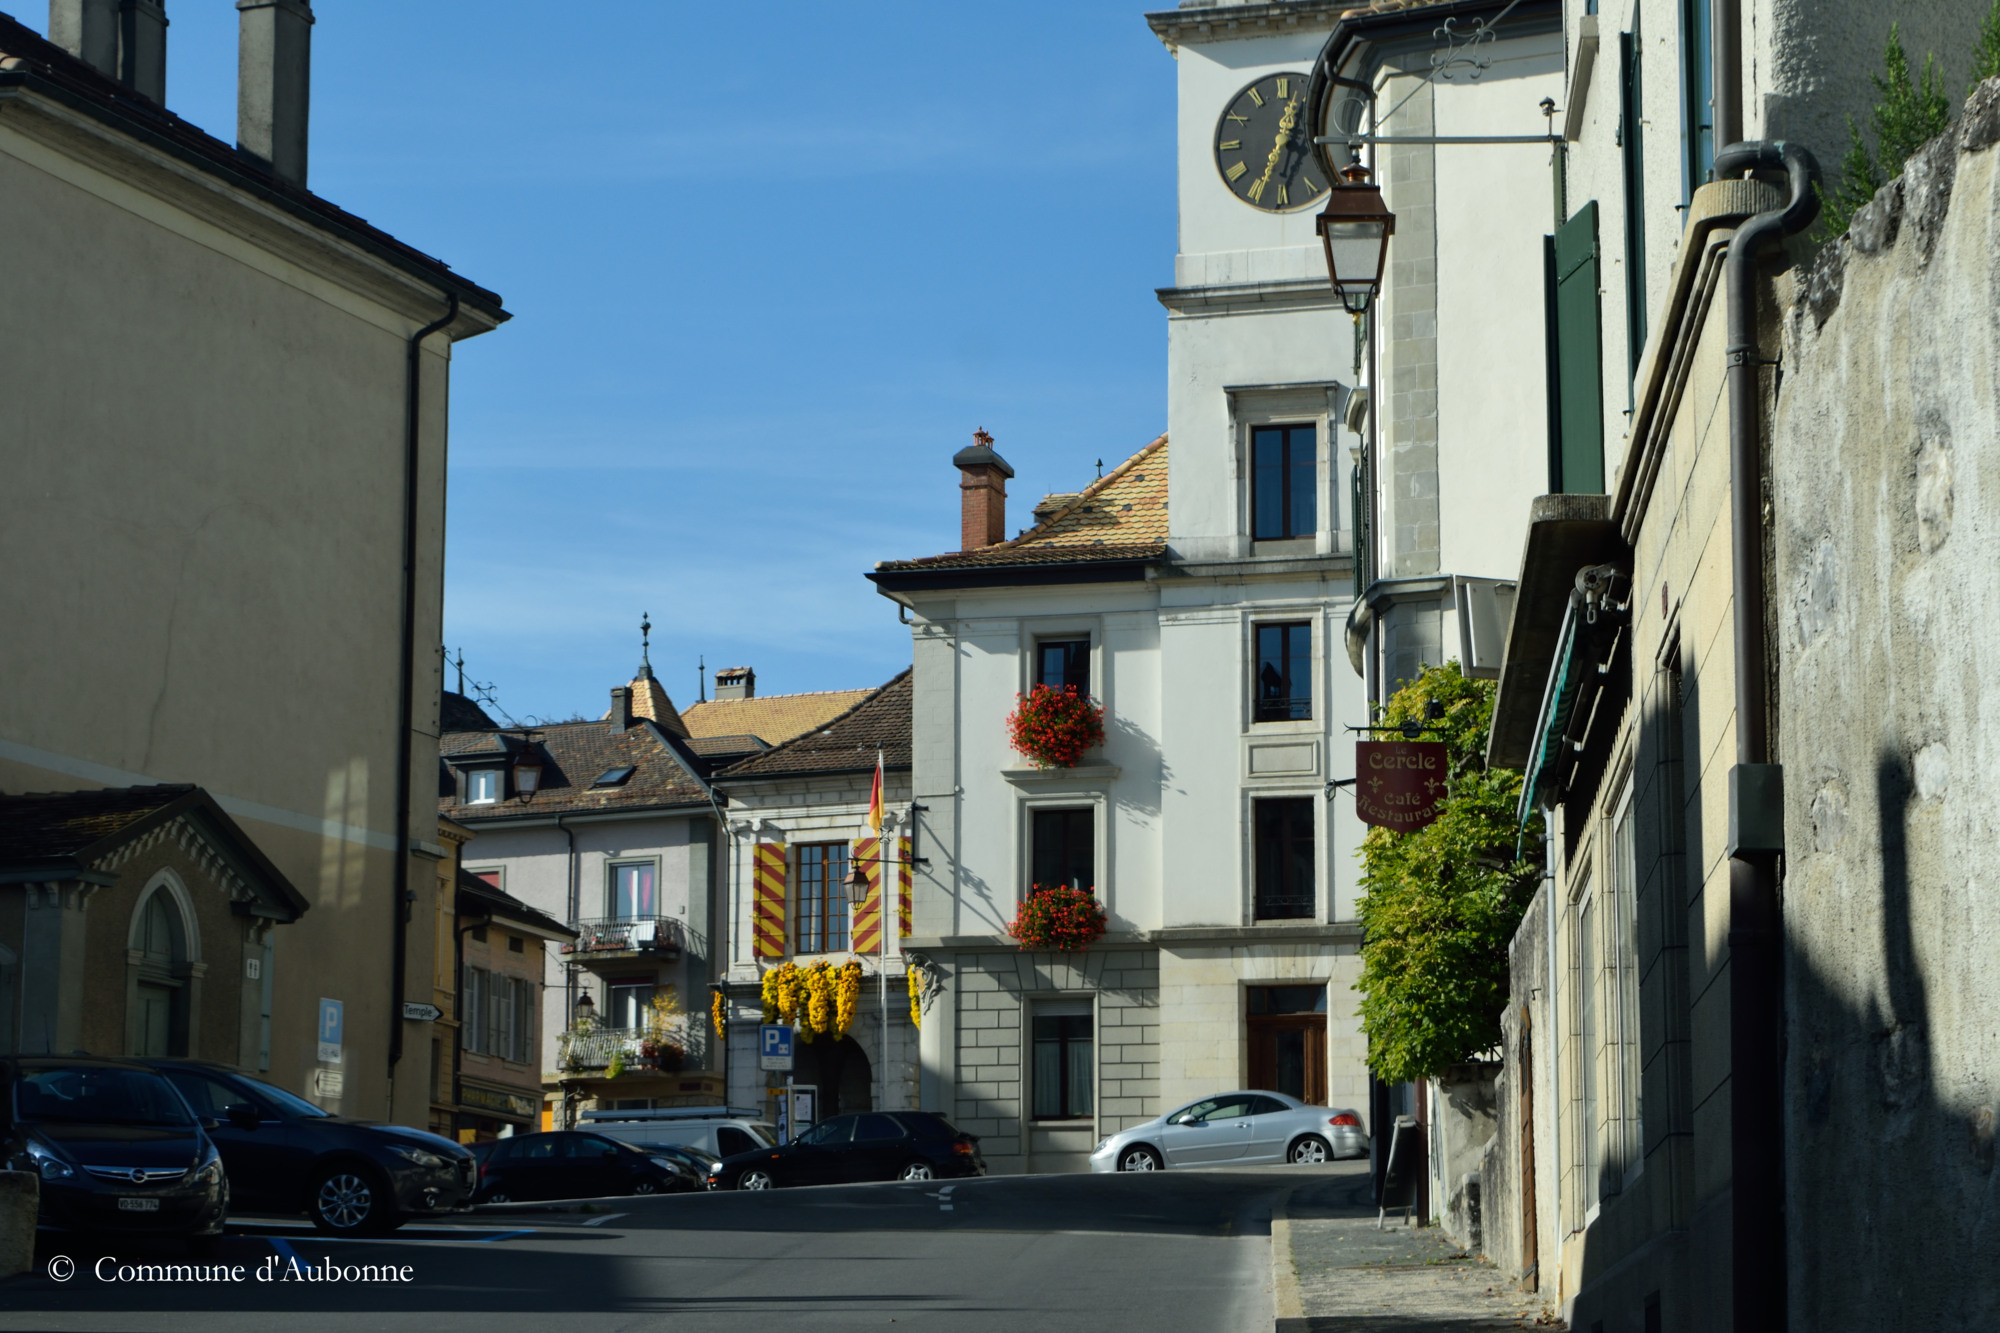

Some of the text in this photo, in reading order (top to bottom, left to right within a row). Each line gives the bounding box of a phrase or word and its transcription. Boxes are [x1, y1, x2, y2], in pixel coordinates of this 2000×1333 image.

[1226, 109, 1248, 127] X
[1369, 752, 1436, 769] Cercle
[1384, 792, 1421, 805] Café
[404, 1004, 433, 1018] Temple
[325, 1006, 338, 1039] P
[765, 1029, 780, 1052] P
